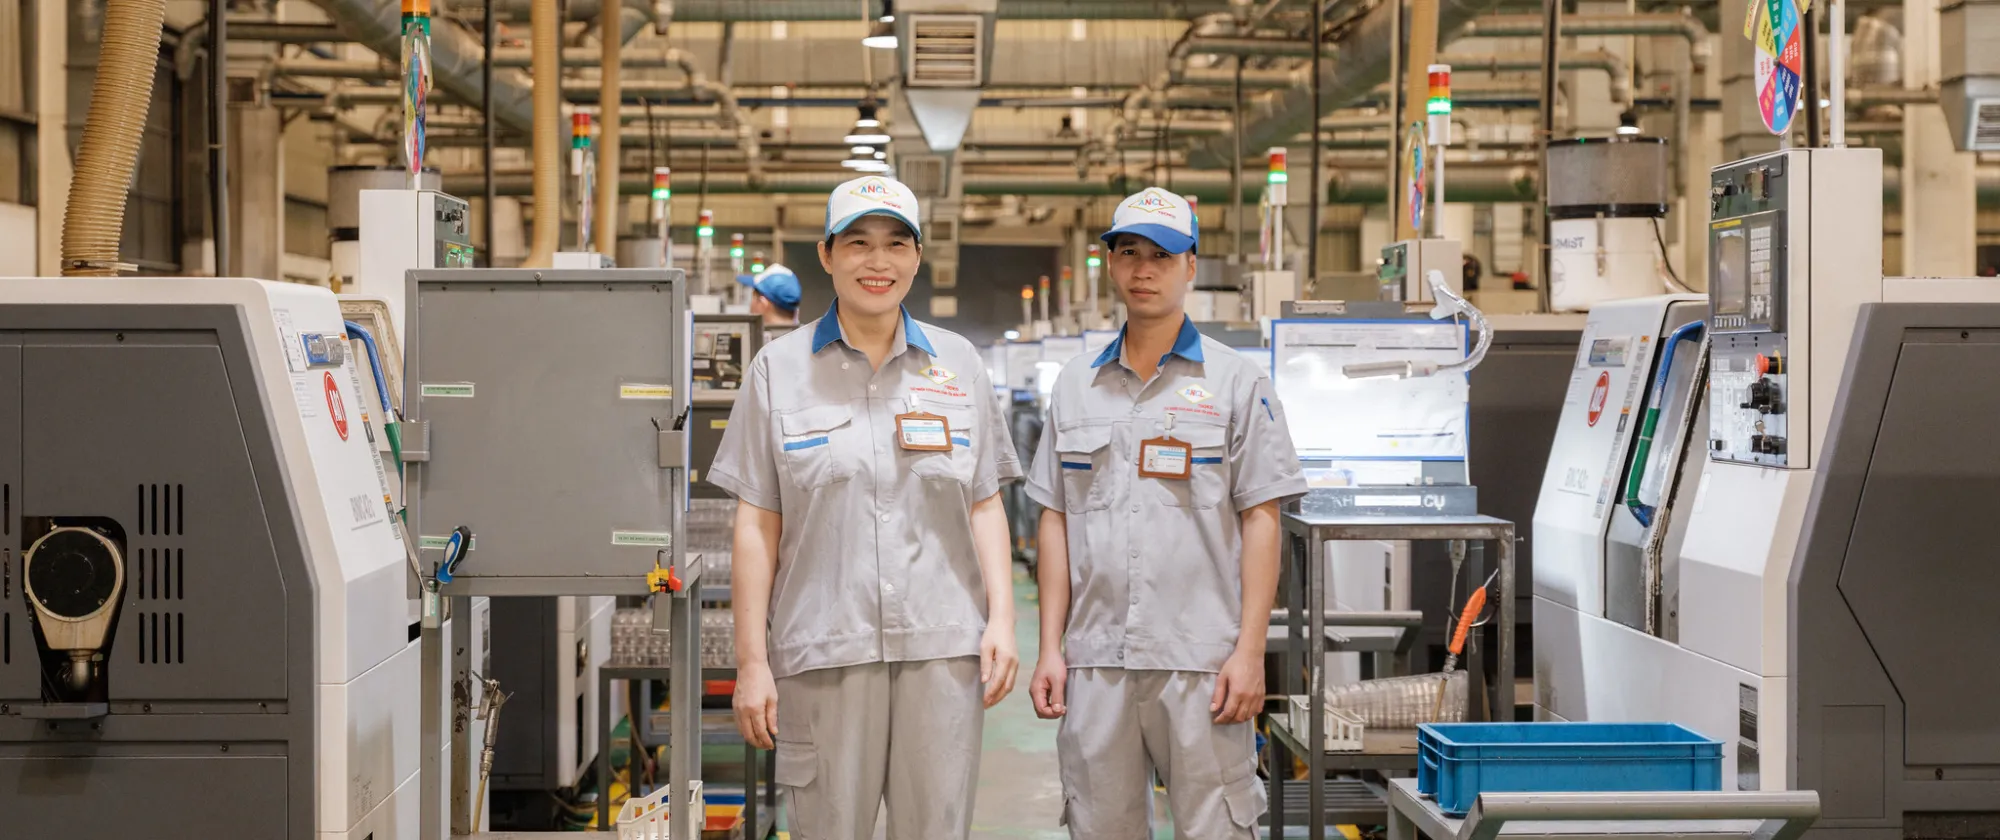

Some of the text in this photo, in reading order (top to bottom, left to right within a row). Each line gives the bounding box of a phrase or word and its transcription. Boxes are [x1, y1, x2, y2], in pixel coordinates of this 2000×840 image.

[860, 184, 889, 195] ANCL
[1138, 197, 1165, 207] ANCL
[928, 368, 949, 379] ANCL
[1184, 388, 1205, 398] ANCL
[1423, 494, 1446, 511] CỤ
